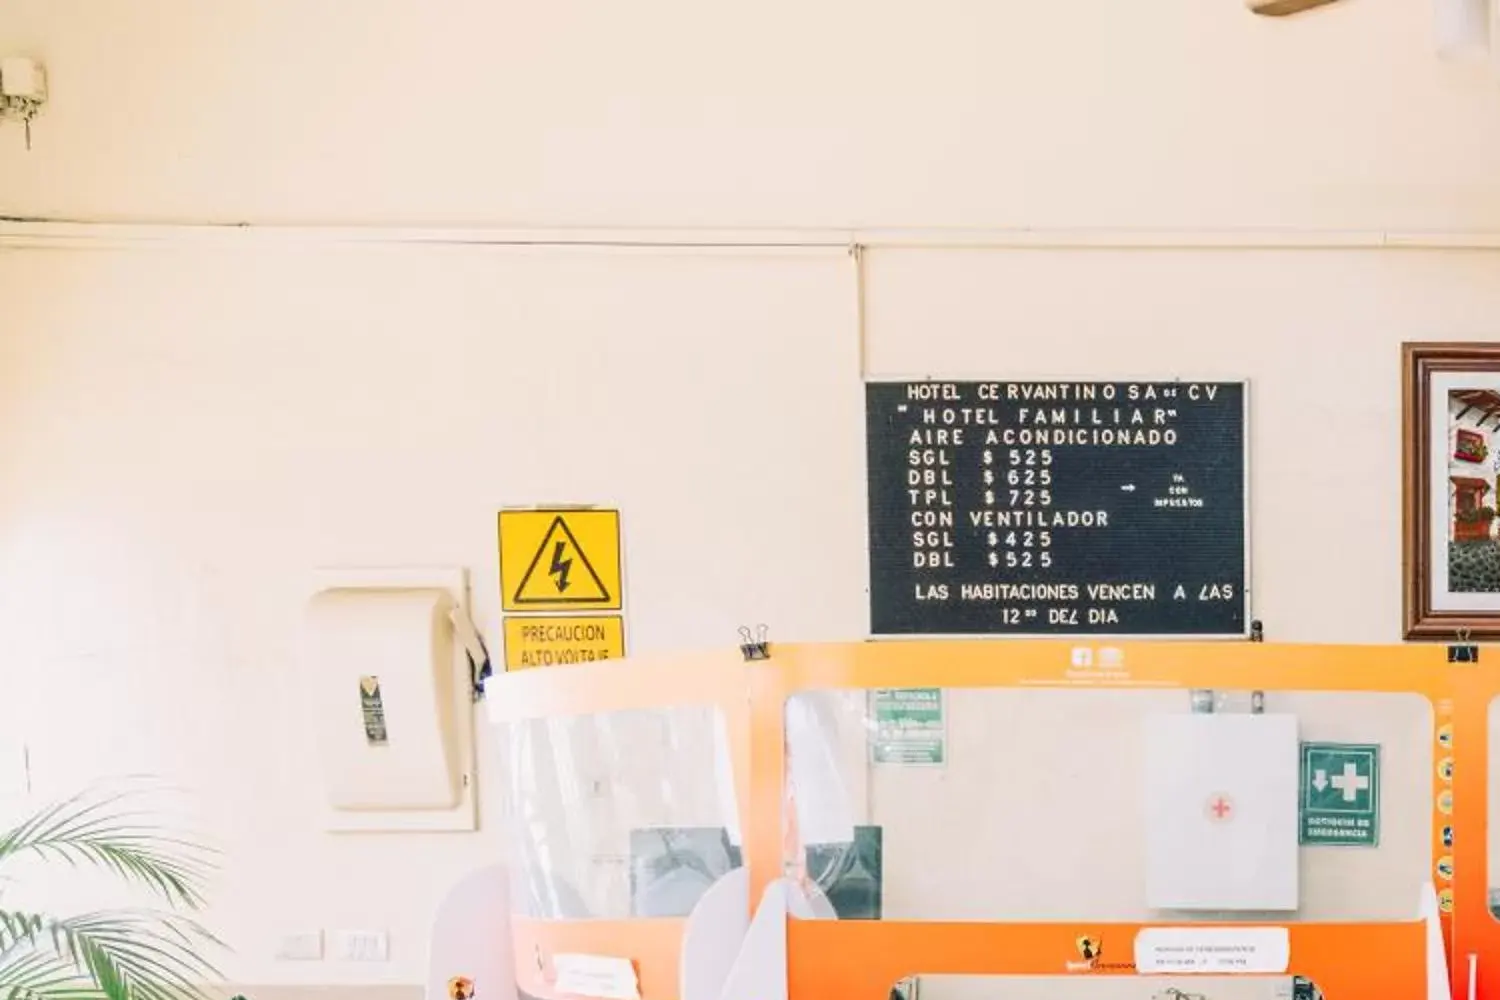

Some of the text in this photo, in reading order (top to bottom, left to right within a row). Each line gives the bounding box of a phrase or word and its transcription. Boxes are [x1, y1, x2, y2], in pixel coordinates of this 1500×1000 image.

[907, 383, 960, 400] HOTEL
[977, 383, 1115, 400] CERVANTINO
[1127, 383, 1156, 400] SA
[1187, 383, 1217, 400] CV
[909, 428, 1176, 445] AIRE ACONDICIONADO
[908, 449, 949, 466] SGL
[1009, 448, 1052, 466] 525
[907, 469, 952, 485] DBL
[1007, 469, 1051, 485] 625
[907, 488, 952, 505] TPL
[1009, 488, 1051, 506] 725
[911, 510, 1108, 526] CON VENTILADOR
[912, 530, 953, 547] SGL
[913, 551, 954, 567] DBL
[915, 583, 949, 600] LAS
[961, 583, 1078, 600] HABITACIONES
[1086, 583, 1155, 600] VENCEN
[1173, 584, 1185, 599] A
[1088, 607, 1118, 624] DIA
[521, 625, 605, 642] PRECAUCION
[521, 650, 551, 666] ALTO
